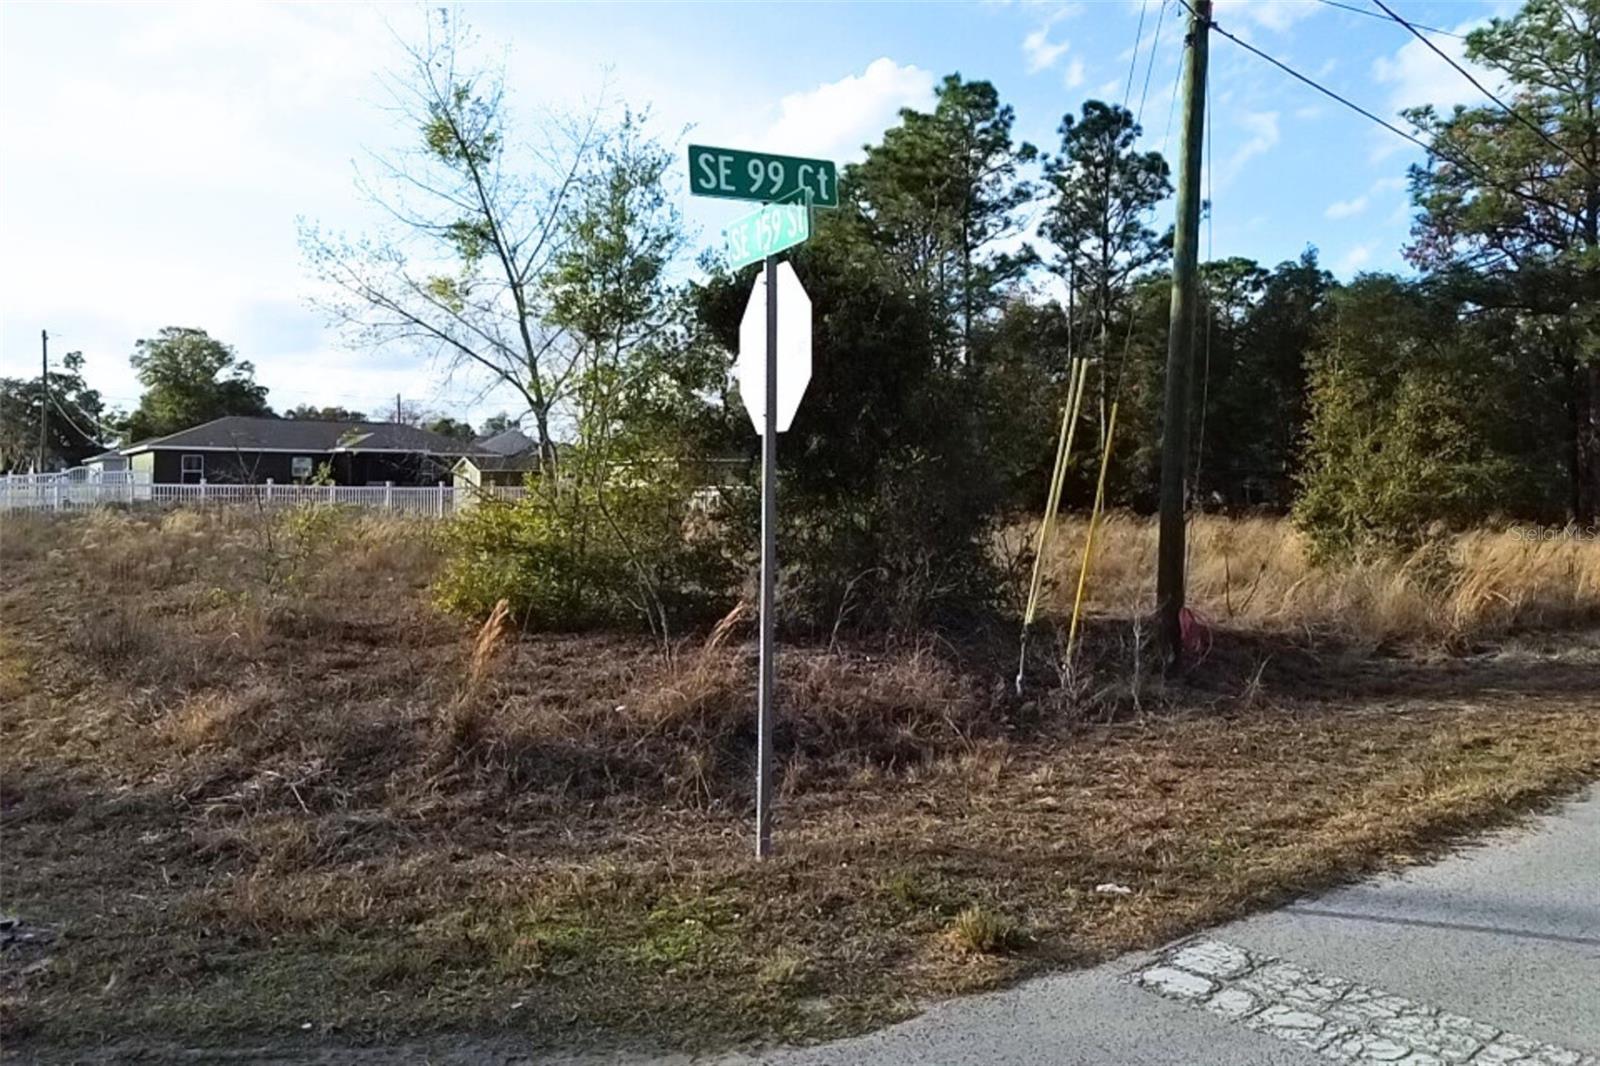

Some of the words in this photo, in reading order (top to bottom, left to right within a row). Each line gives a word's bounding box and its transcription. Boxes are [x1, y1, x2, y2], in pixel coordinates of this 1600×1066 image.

[698, 153, 736, 191] SE
[747, 159, 785, 195] 99
[798, 164, 829, 200] Ct
[731, 221, 750, 261] SE
[755, 207, 781, 252] 159
